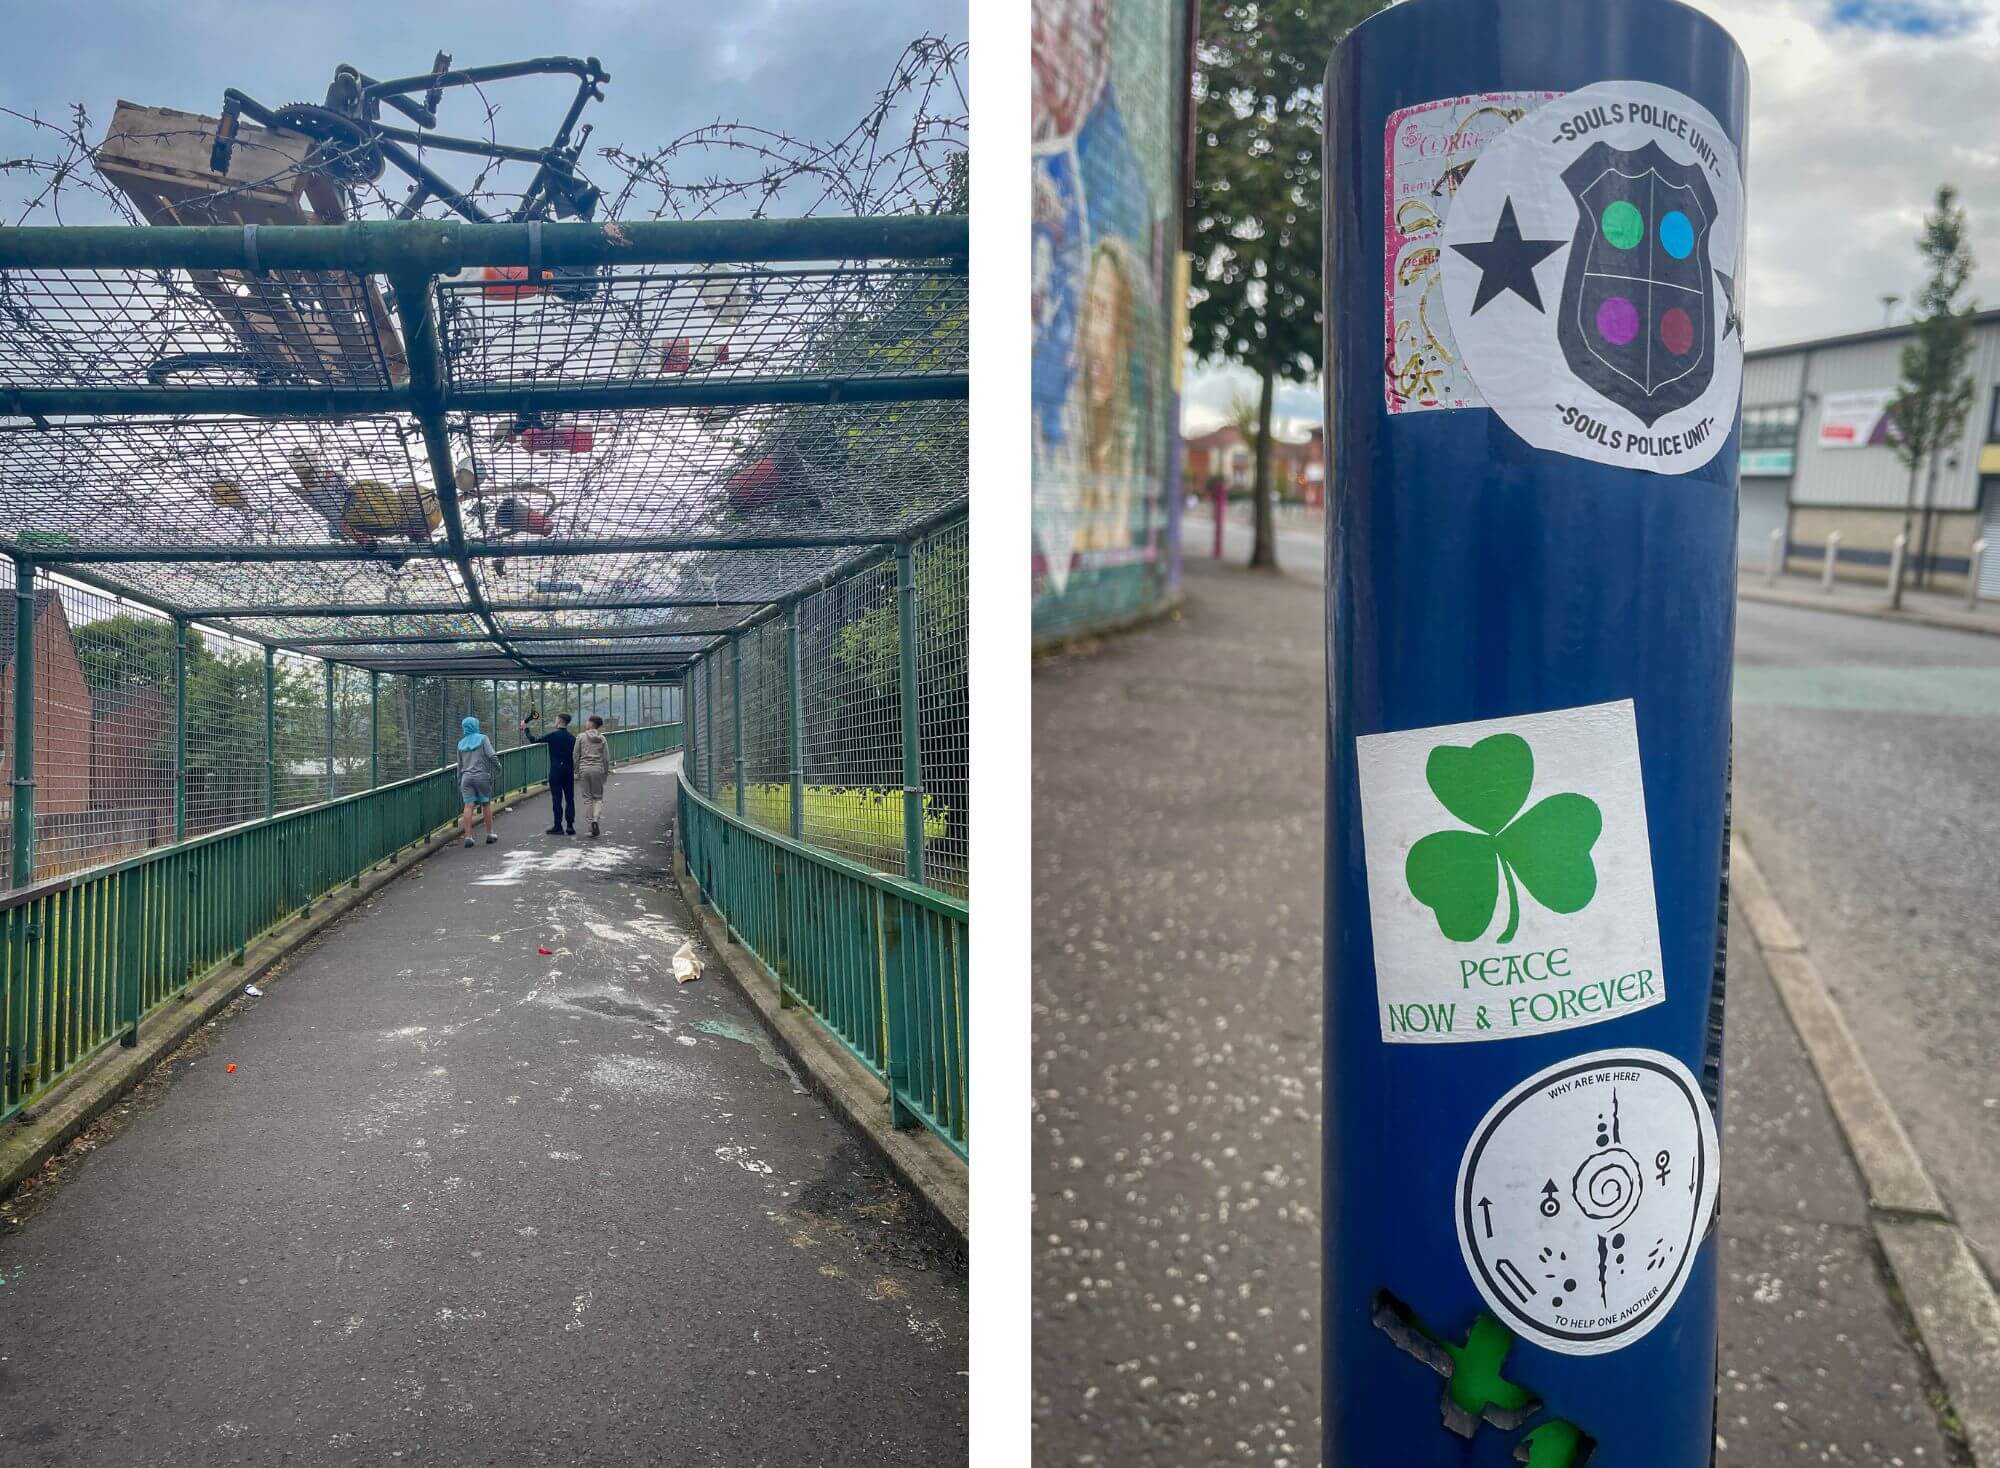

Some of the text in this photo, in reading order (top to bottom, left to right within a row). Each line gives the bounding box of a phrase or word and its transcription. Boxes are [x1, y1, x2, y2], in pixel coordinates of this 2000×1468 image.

[1628, 102, 1688, 140] POLICE
[1626, 433, 1682, 456] POLICE
[1460, 948, 1571, 989] PEACE
[1388, 969, 1655, 1032] NOW & FOREVER
[1548, 1071, 1640, 1099] WHY ARE WE HERE?
[1555, 1286, 1659, 1328] TO HELP ONE ANOTHER
